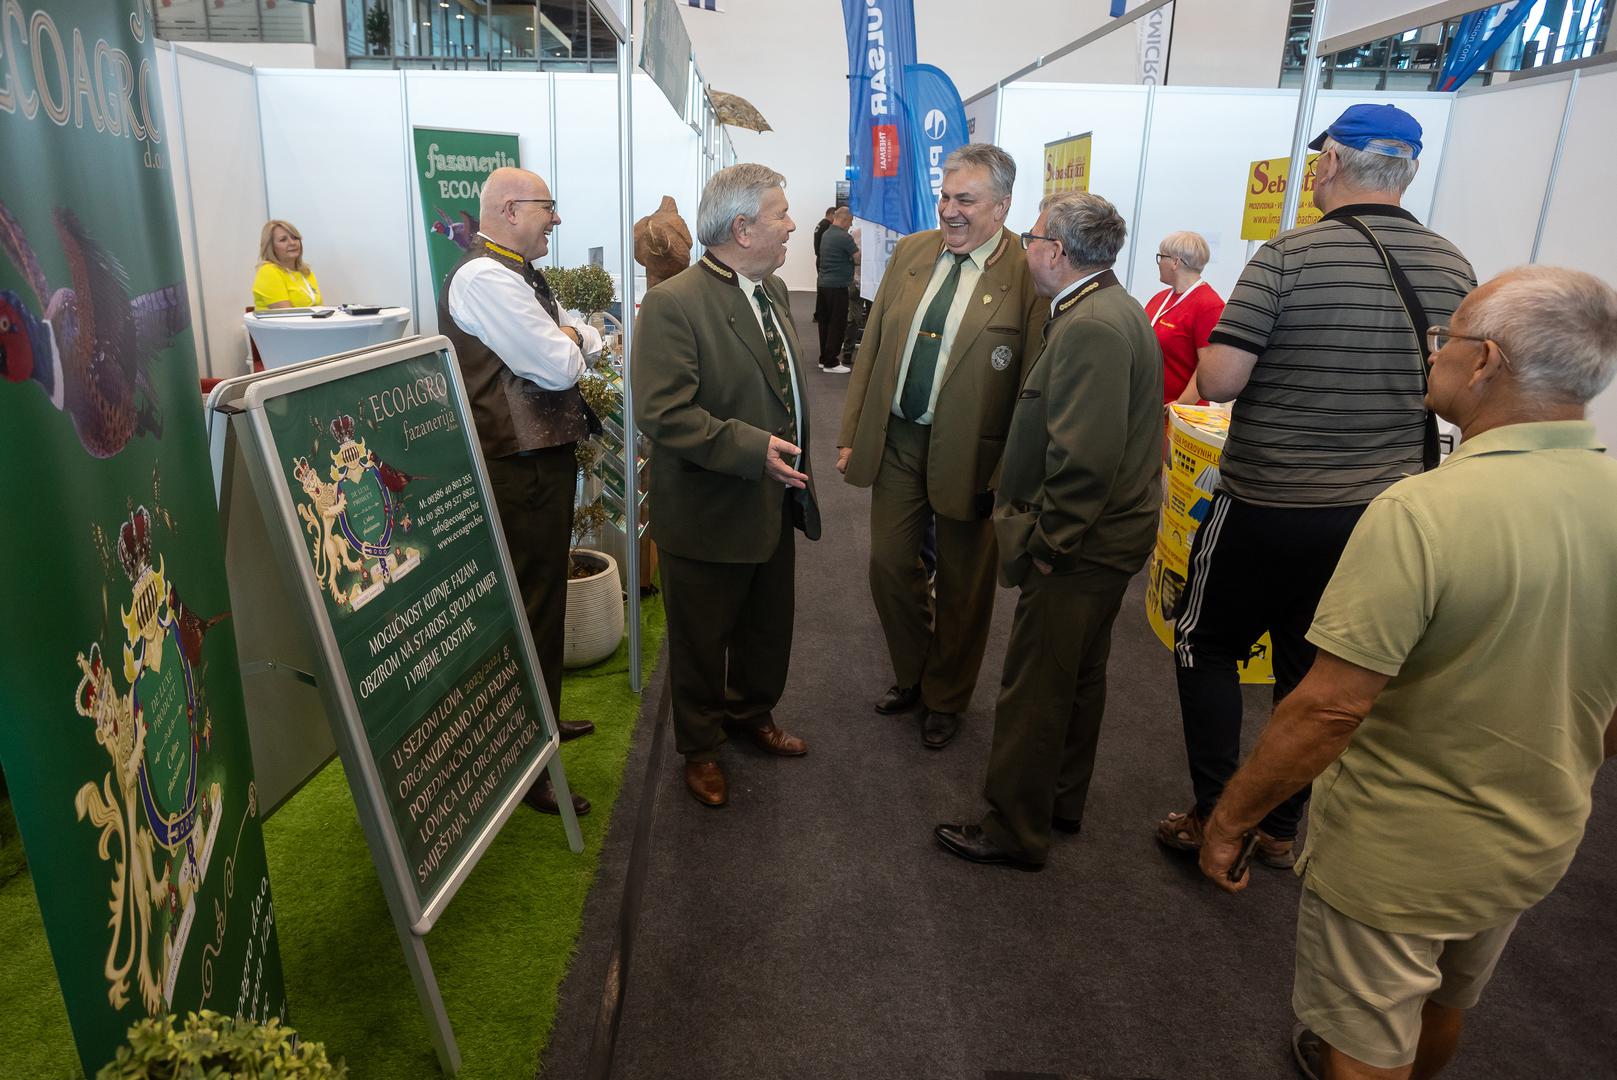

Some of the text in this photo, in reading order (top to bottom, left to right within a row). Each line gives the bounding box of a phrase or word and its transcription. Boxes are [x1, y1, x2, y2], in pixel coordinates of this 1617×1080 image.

[369, 372, 447, 422] ECOAGRO
[403, 408, 456, 451] fazanerija
[1183, 438, 1212, 459] POKROVNIH
[417, 486, 476, 528] M: 00 385 99 527 8822
[418, 474, 473, 510] M: 00386 40 802 355
[432, 500, 480, 536] info@ecoagro.biz
[437, 514, 484, 550] www.ecoagro.biz
[359, 570, 498, 699] OBZIROM NA STAROST, SPOLNI OMJER
[368, 600, 423, 657] MOGUĆNOST
[422, 579, 451, 612] KUPNJE
[450, 559, 479, 589] FAZANA
[404, 616, 477, 691] I VRIJEME DOSTAVE
[392, 749, 404, 770] U
[402, 711, 441, 760] SEZONI
[438, 687, 464, 720] LOVA
[399, 659, 519, 799] ORGANIZIRAMO LOV FAZANA
[408, 682, 523, 822] POJEDINAČNO ILI ZA GRUPE
[417, 719, 540, 884] SMJEŠTAJA, HRANE I PRIJEVOZA.
[420, 705, 526, 844] LOVACA UZ ORGANIZACIJU
[251, 876, 269, 936] d.o.o.
